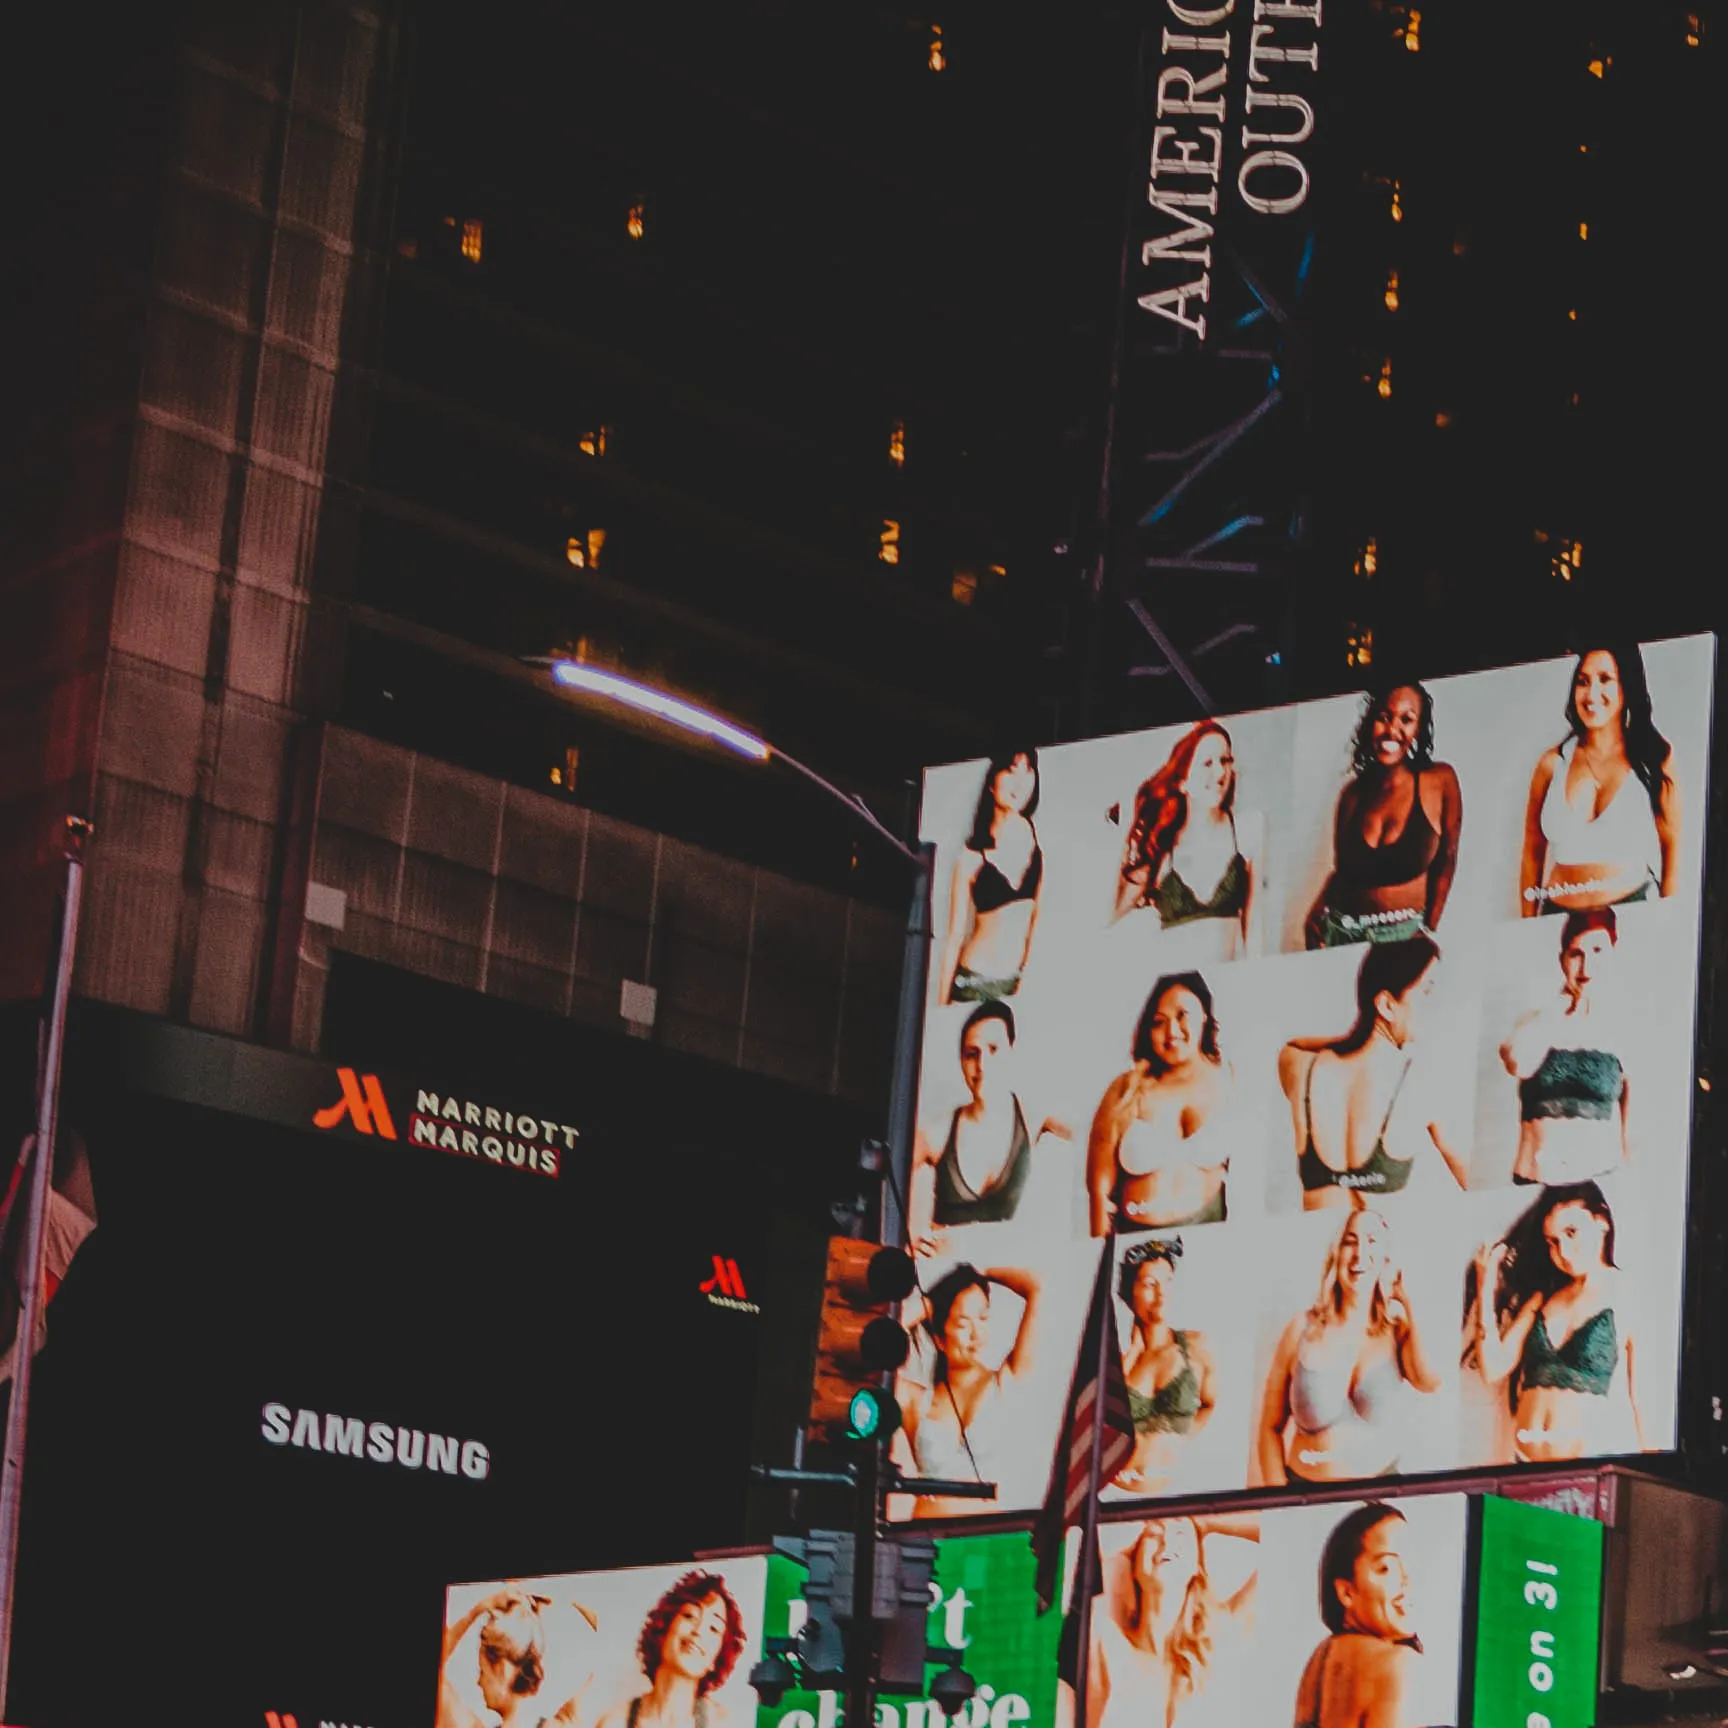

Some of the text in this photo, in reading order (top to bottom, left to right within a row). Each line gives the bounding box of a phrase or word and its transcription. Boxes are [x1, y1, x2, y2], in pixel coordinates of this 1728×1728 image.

[413, 1118, 559, 1176] MARQUIS
[416, 1088, 579, 1149] MARRIOTT
[261, 1402, 490, 1480] SAMSUNG
[1523, 1559, 1558, 1611] 31
[1528, 1630, 1556, 1693] on
